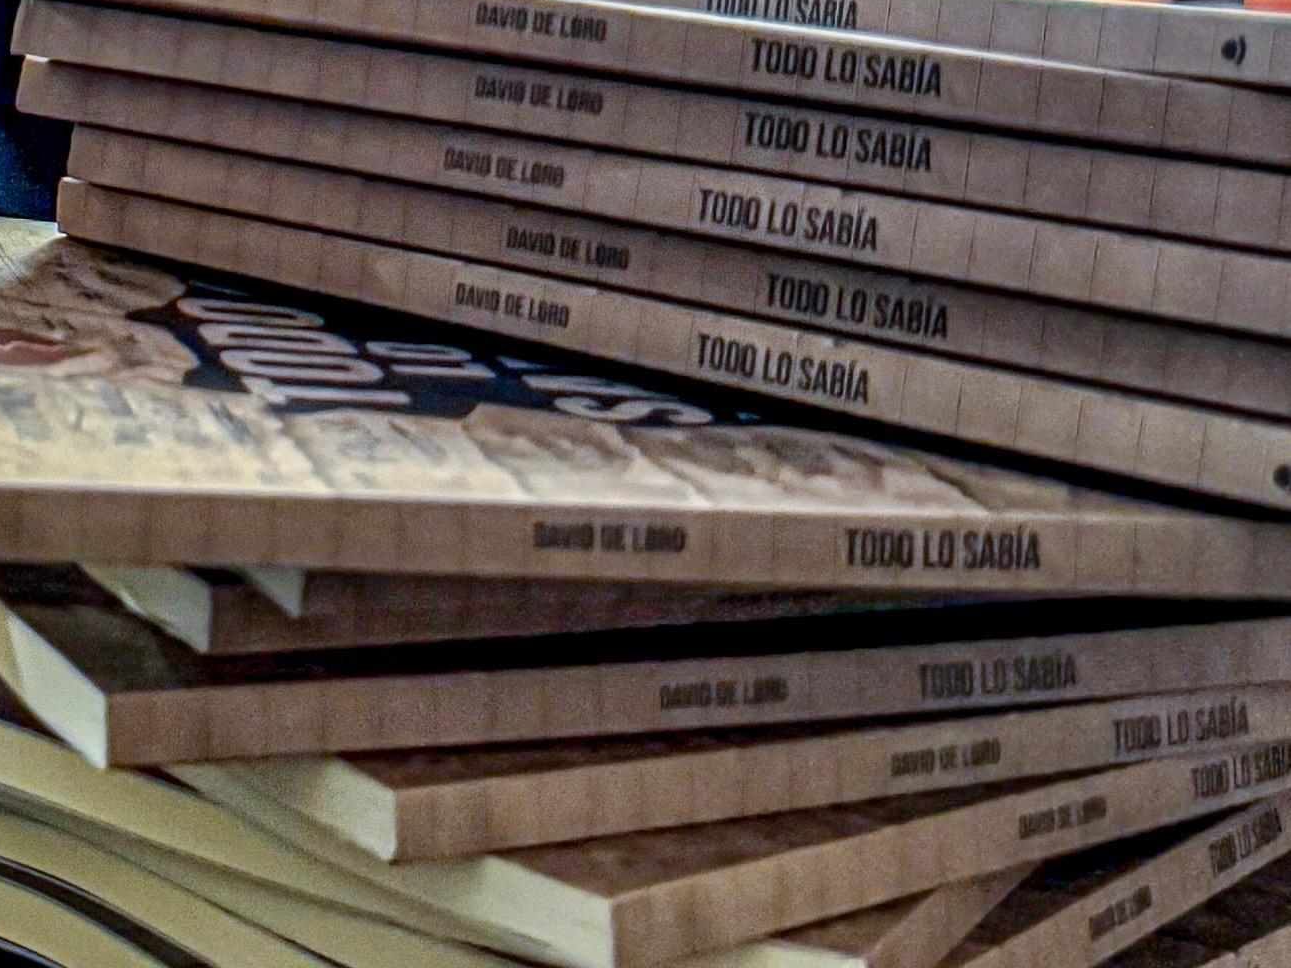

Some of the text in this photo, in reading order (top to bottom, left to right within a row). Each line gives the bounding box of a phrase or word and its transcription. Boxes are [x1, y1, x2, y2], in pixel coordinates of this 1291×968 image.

[751, 39, 942, 96] TODO LO SABÍA
[745, 113, 930, 171] TODO LO SABÍA
[700, 190, 877, 251] TODO LO SABÍA
[766, 275, 947, 338] TODO LO SABÍA
[698, 335, 867, 403] TODO LO SABÍA
[846, 522, 1040, 570] TODO LO SABÍA
